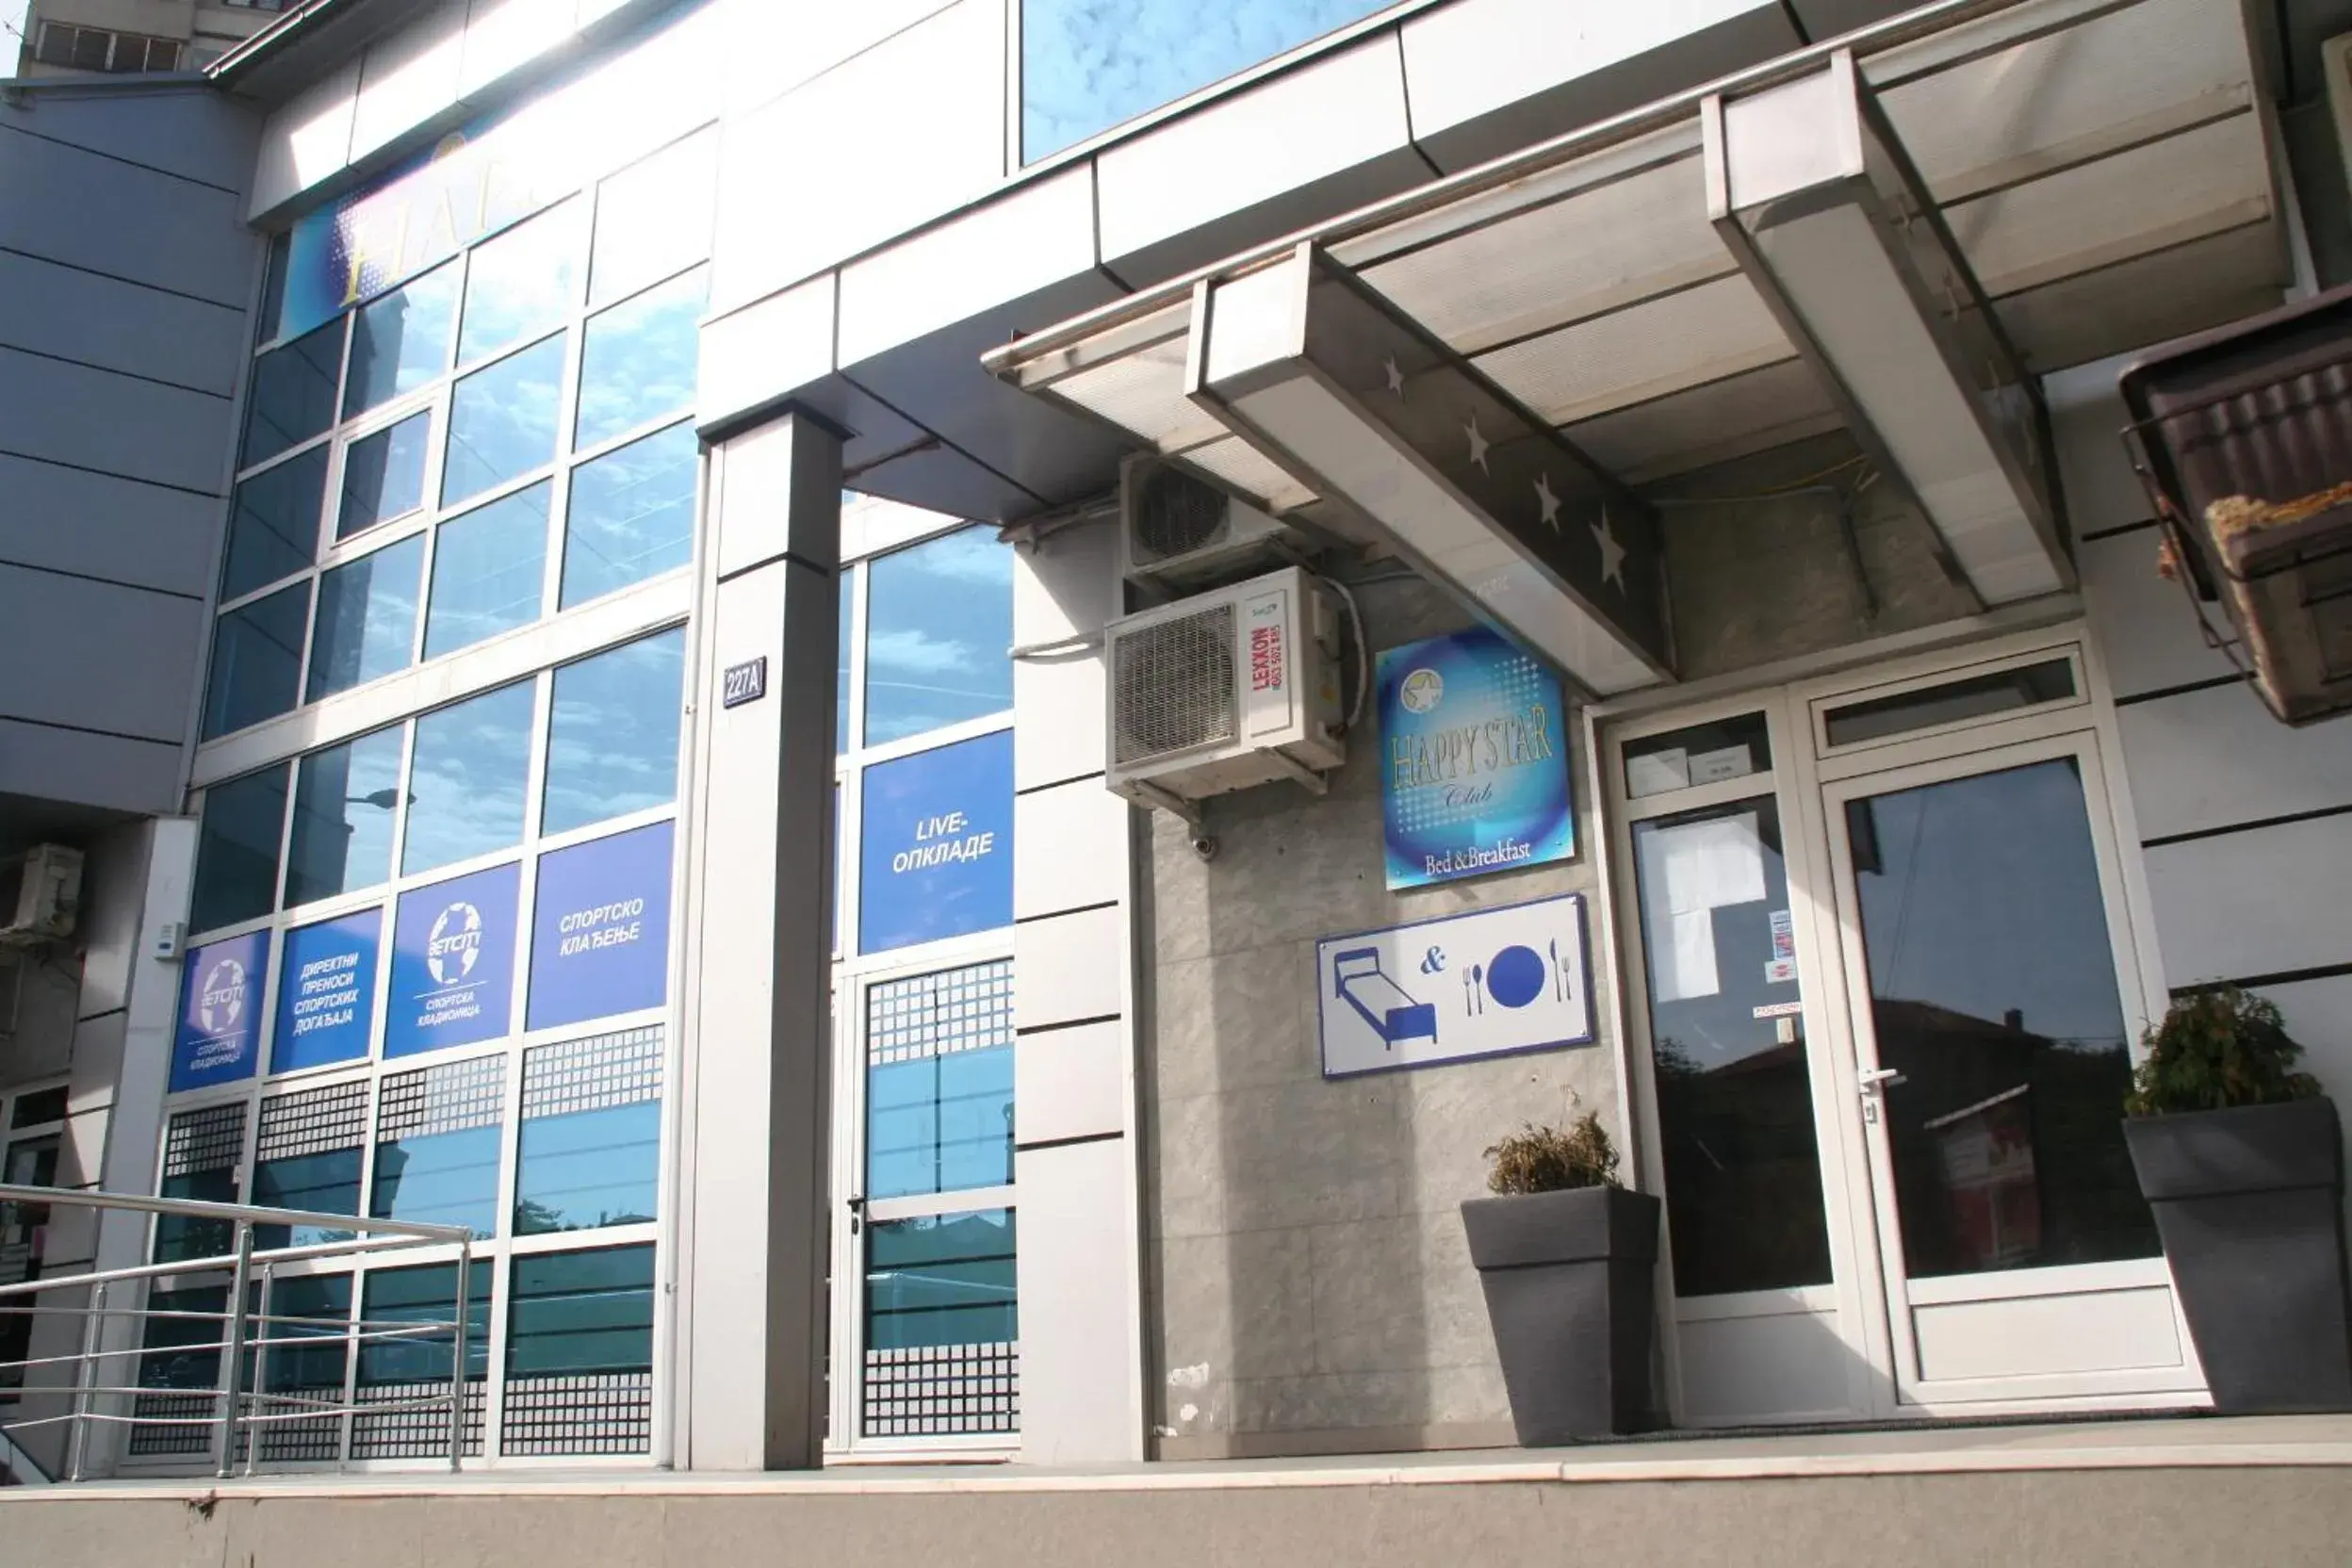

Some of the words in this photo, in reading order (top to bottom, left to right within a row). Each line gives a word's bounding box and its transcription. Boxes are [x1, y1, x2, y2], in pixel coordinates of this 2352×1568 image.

[727, 667, 760, 698] 227A
[1440, 781, 1493, 808] Club
[916, 811, 969, 841] LIVE-
[892, 832, 995, 874] ОПКЛАДЕ
[1425, 850, 1452, 876] Bed
[559, 897, 645, 933] СПОРТСКО
[559, 922, 640, 957] КЛАЂЕЊЕ
[300, 952, 359, 981] ДИРЕКТНИ
[302, 972, 354, 995] ПРЕНОСИ
[294, 988, 359, 1015] СПОРТСКИХ
[293, 1008, 353, 1037] ДОГАЂАЈА
